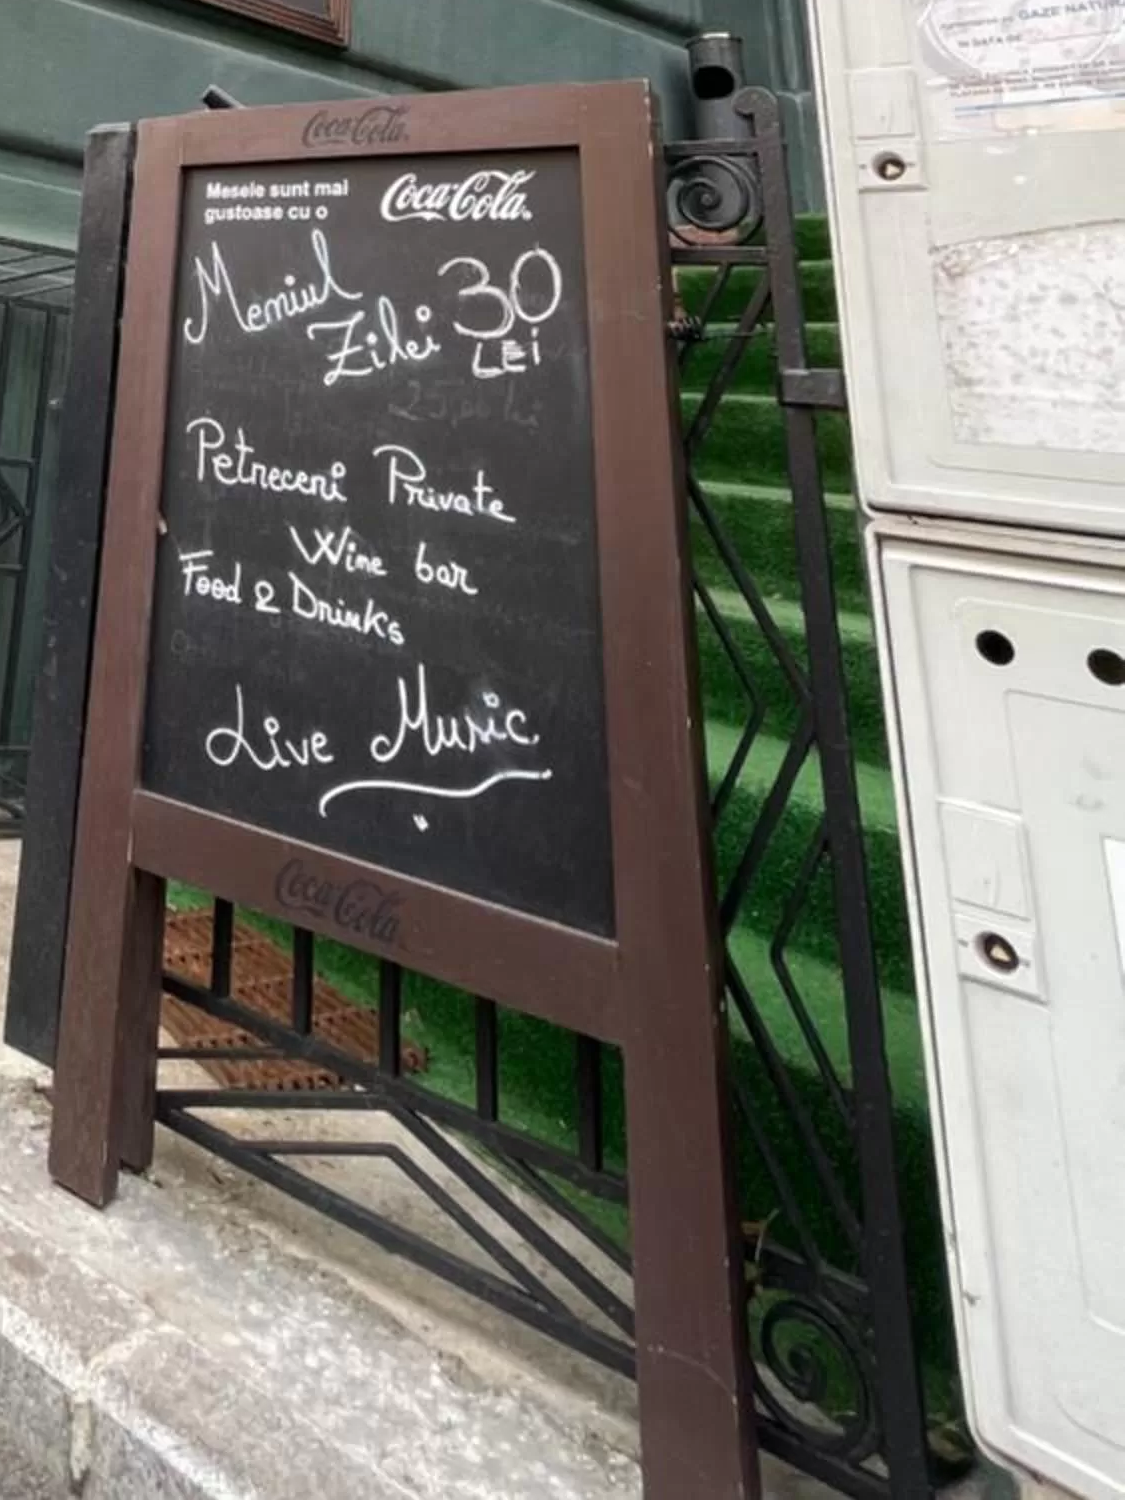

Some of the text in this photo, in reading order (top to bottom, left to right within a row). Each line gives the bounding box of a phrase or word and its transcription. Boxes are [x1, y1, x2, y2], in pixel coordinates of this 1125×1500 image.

[204, 204, 329, 225] gustoase cu o
[206, 181, 265, 199] Mesele
[269, 180, 311, 198] sunt
[379, 169, 537, 222] Coca-Cola
[184, 228, 563, 344] Meniul 30
[306, 295, 441, 387] Zilei
[185, 416, 517, 523] Petreceri Private
[178, 550, 242, 604] Food
[287, 571, 406, 646] Drinks
[287, 524, 479, 595] Wine bar
[205, 661, 540, 770] Live Music
